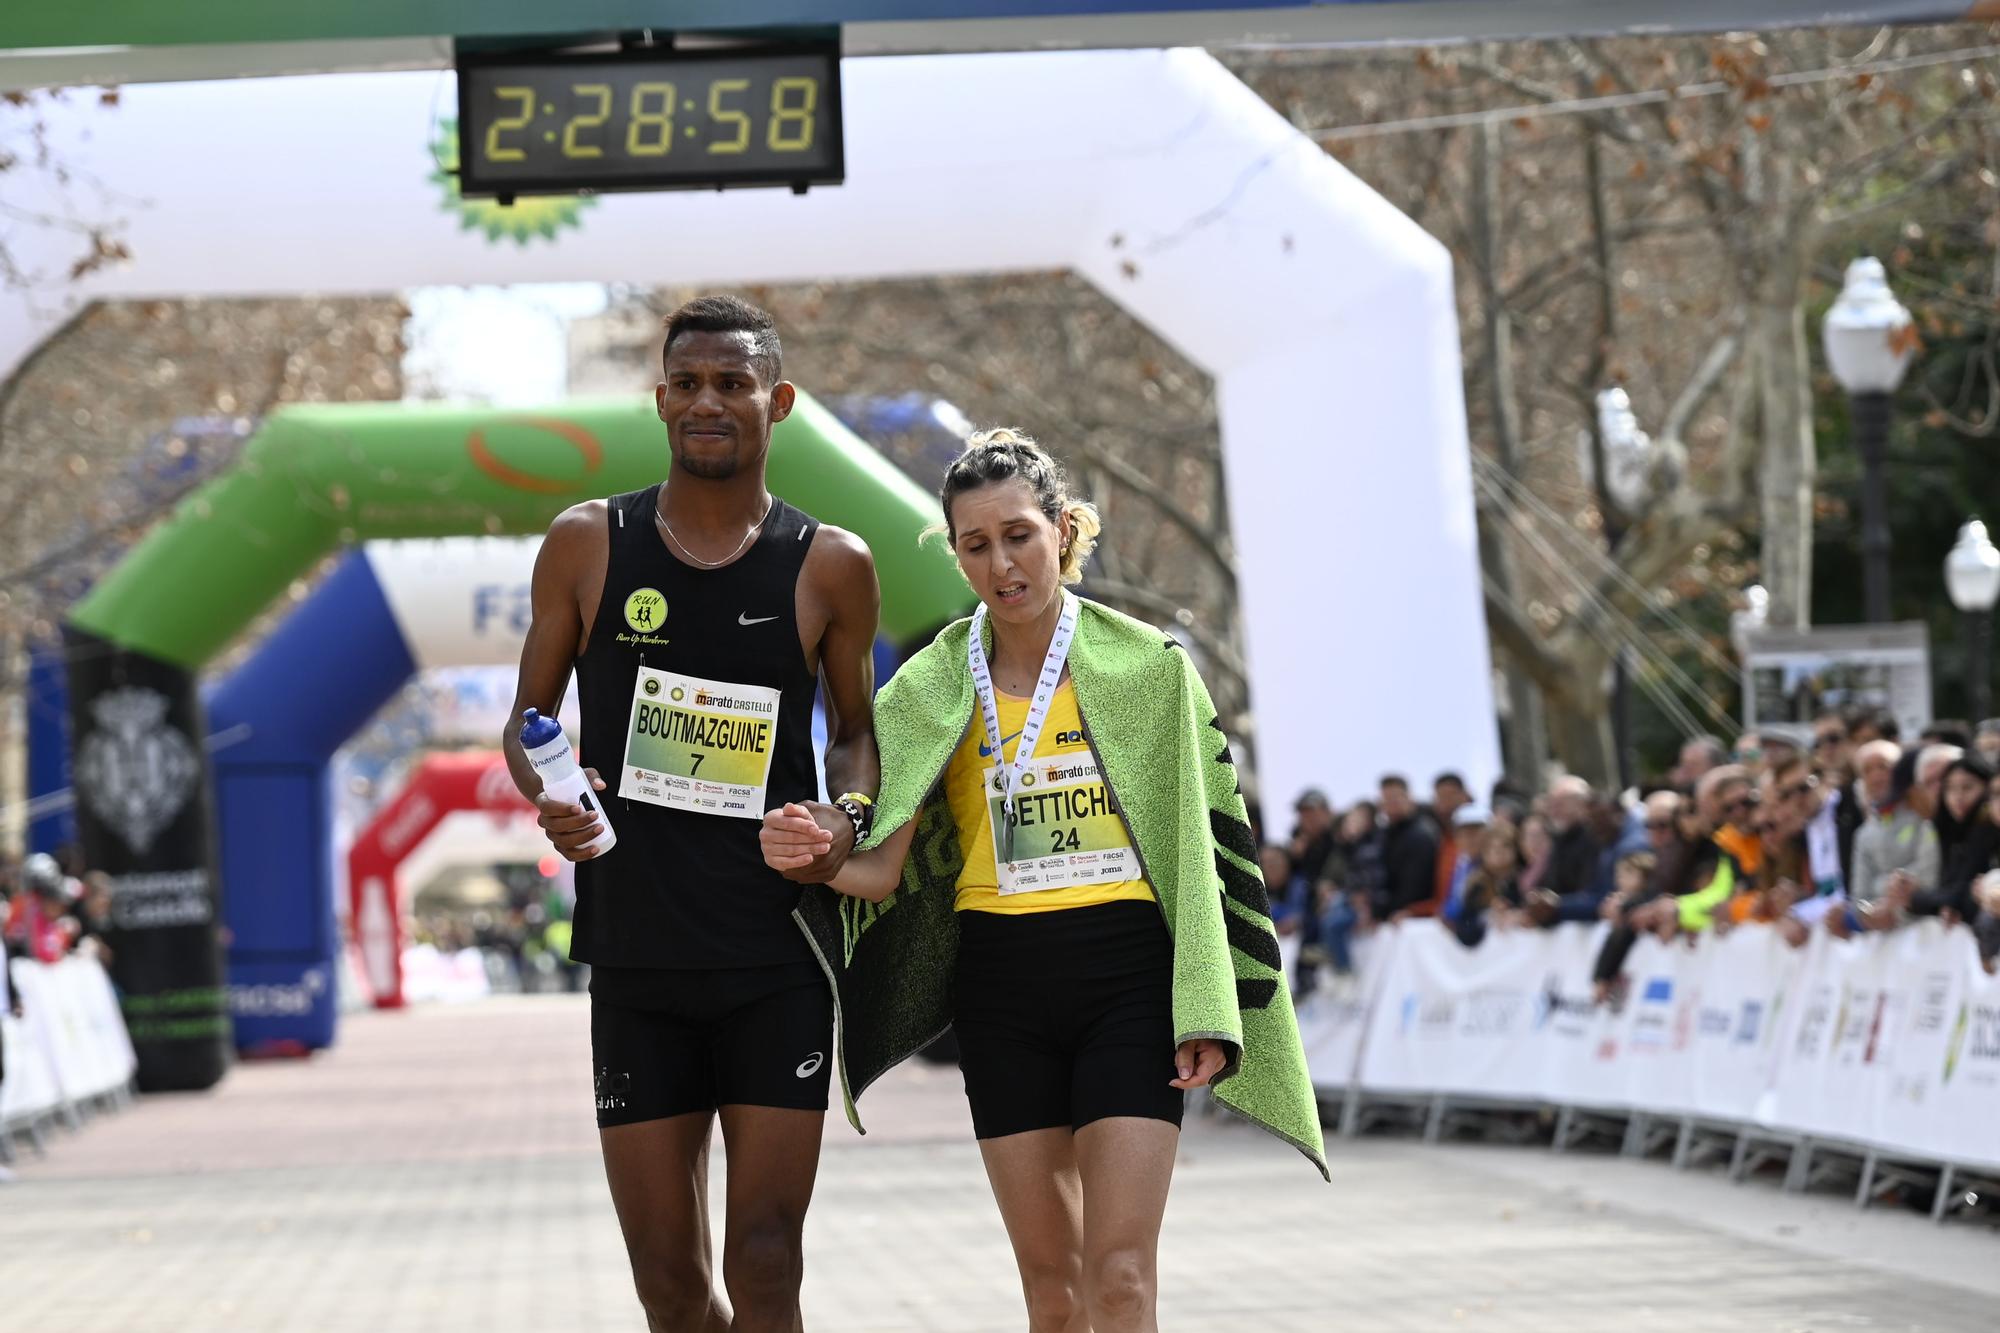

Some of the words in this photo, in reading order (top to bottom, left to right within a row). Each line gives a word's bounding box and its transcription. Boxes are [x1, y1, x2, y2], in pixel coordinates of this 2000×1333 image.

[484, 77, 818, 161] 2:28:58
[633, 595, 661, 605] RUN
[696, 694, 733, 709] marató
[734, 700, 773, 713] CASTELLÓ
[637, 704, 768, 753] BOUTMAZGUINE
[690, 753, 705, 776] 7
[1048, 765, 1083, 781] marató
[1050, 827, 1080, 853] 24
